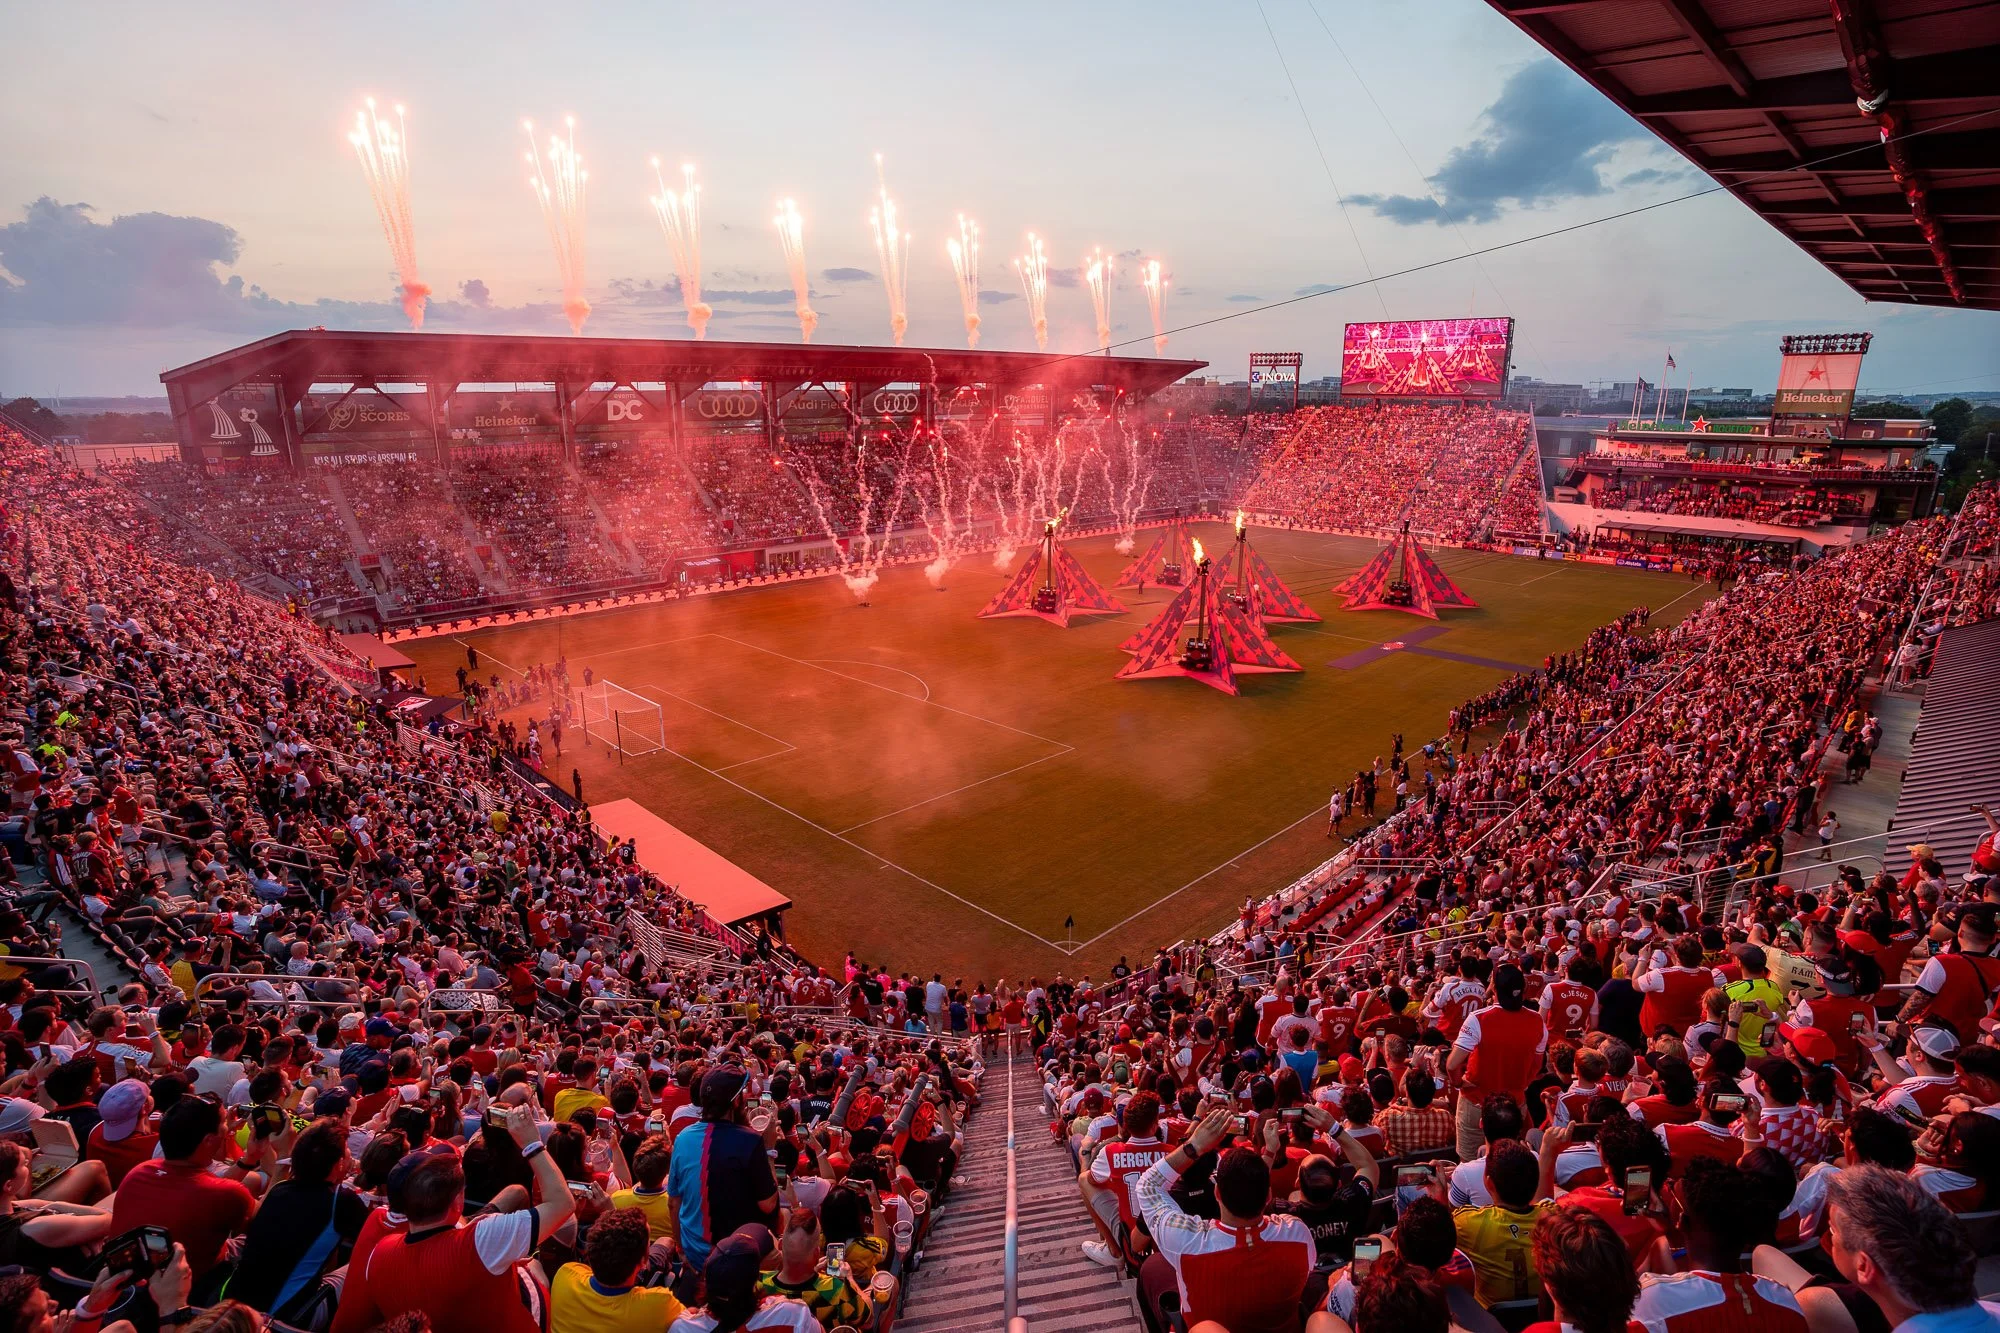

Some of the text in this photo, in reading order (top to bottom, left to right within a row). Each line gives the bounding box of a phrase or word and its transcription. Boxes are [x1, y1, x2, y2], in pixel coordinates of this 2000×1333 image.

[1262, 372, 1297, 382] INOVA
[1782, 392, 1843, 403] Heineken
[360, 404, 375, 412] DC
[788, 400, 845, 410] Audi Fiel
[608, 400, 644, 421] DC
[360, 412, 410, 422] SCORES
[475, 415, 537, 427] Heineken
[1712, 424, 1753, 434] ROOFTOP
[1087, 1013, 1096, 1025] 8
[1565, 1004, 1583, 1025] 9
[1333, 1023, 1346, 1040] 9
[810, 1100, 831, 1109] WHITE
